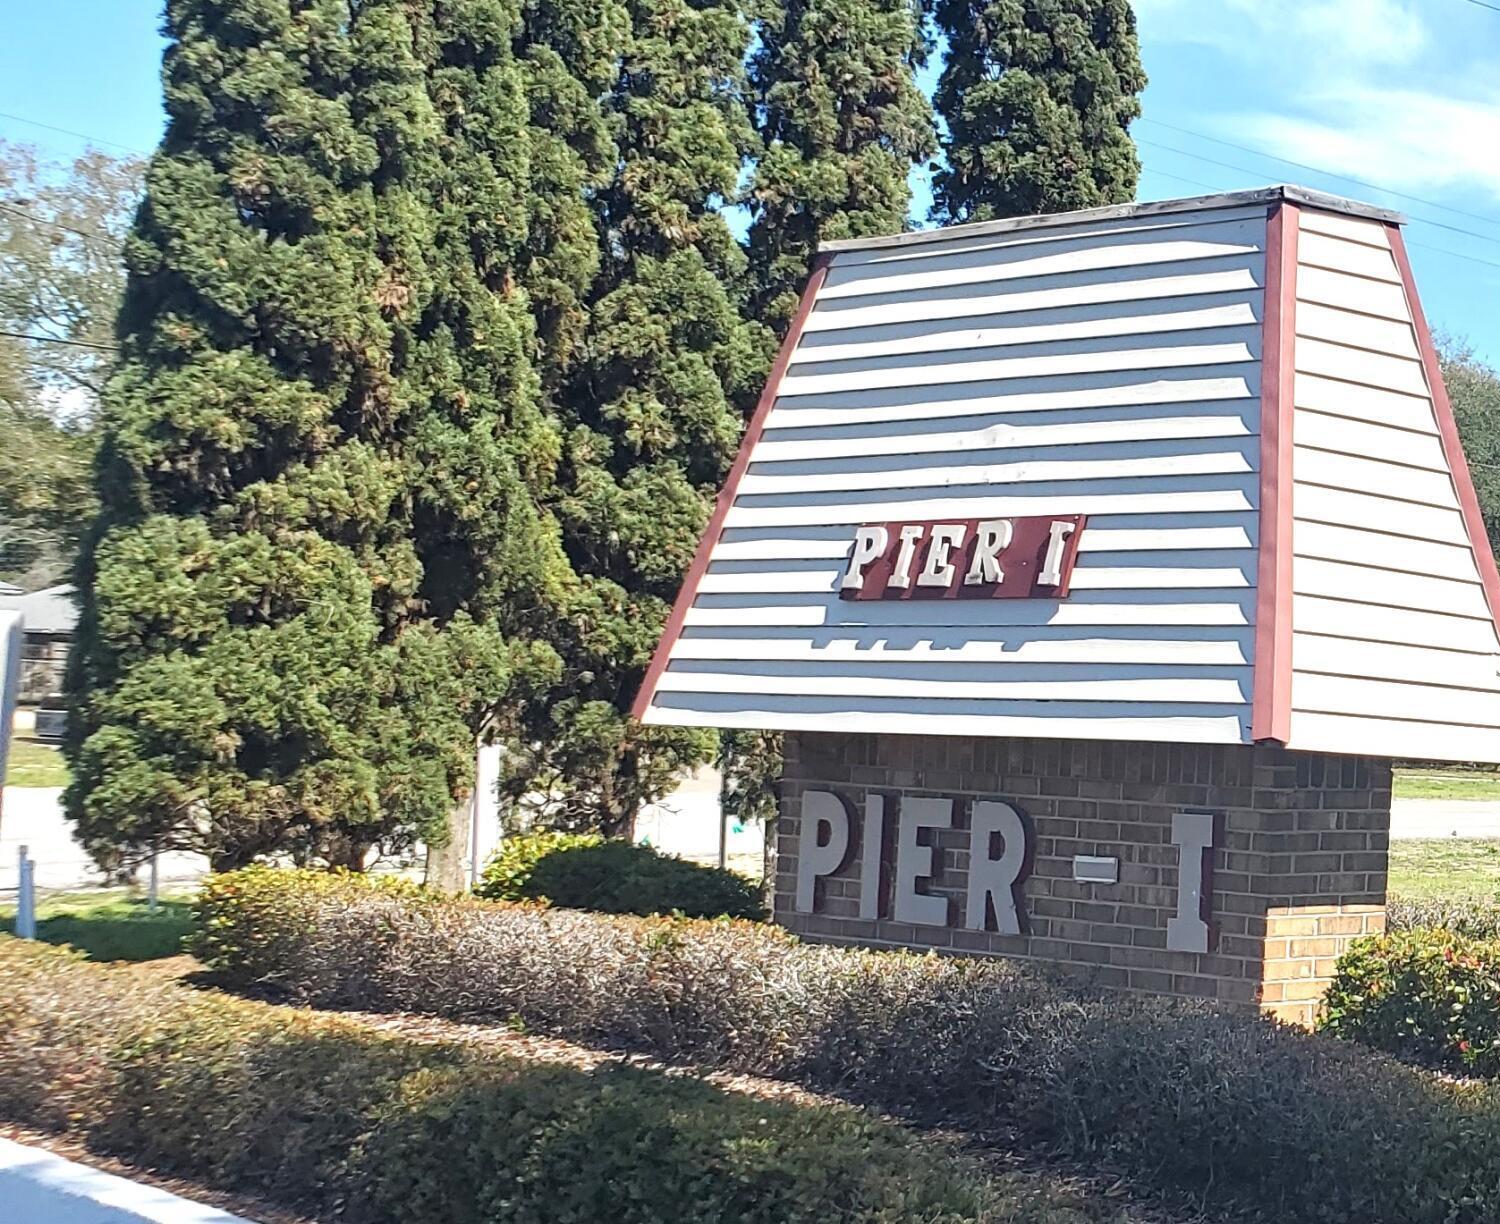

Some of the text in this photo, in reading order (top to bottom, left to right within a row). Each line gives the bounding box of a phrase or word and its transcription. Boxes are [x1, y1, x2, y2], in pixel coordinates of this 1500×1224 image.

[842, 519, 1075, 588] PIER I
[796, 790, 1027, 934] PIER
[1167, 812, 1214, 953] I
